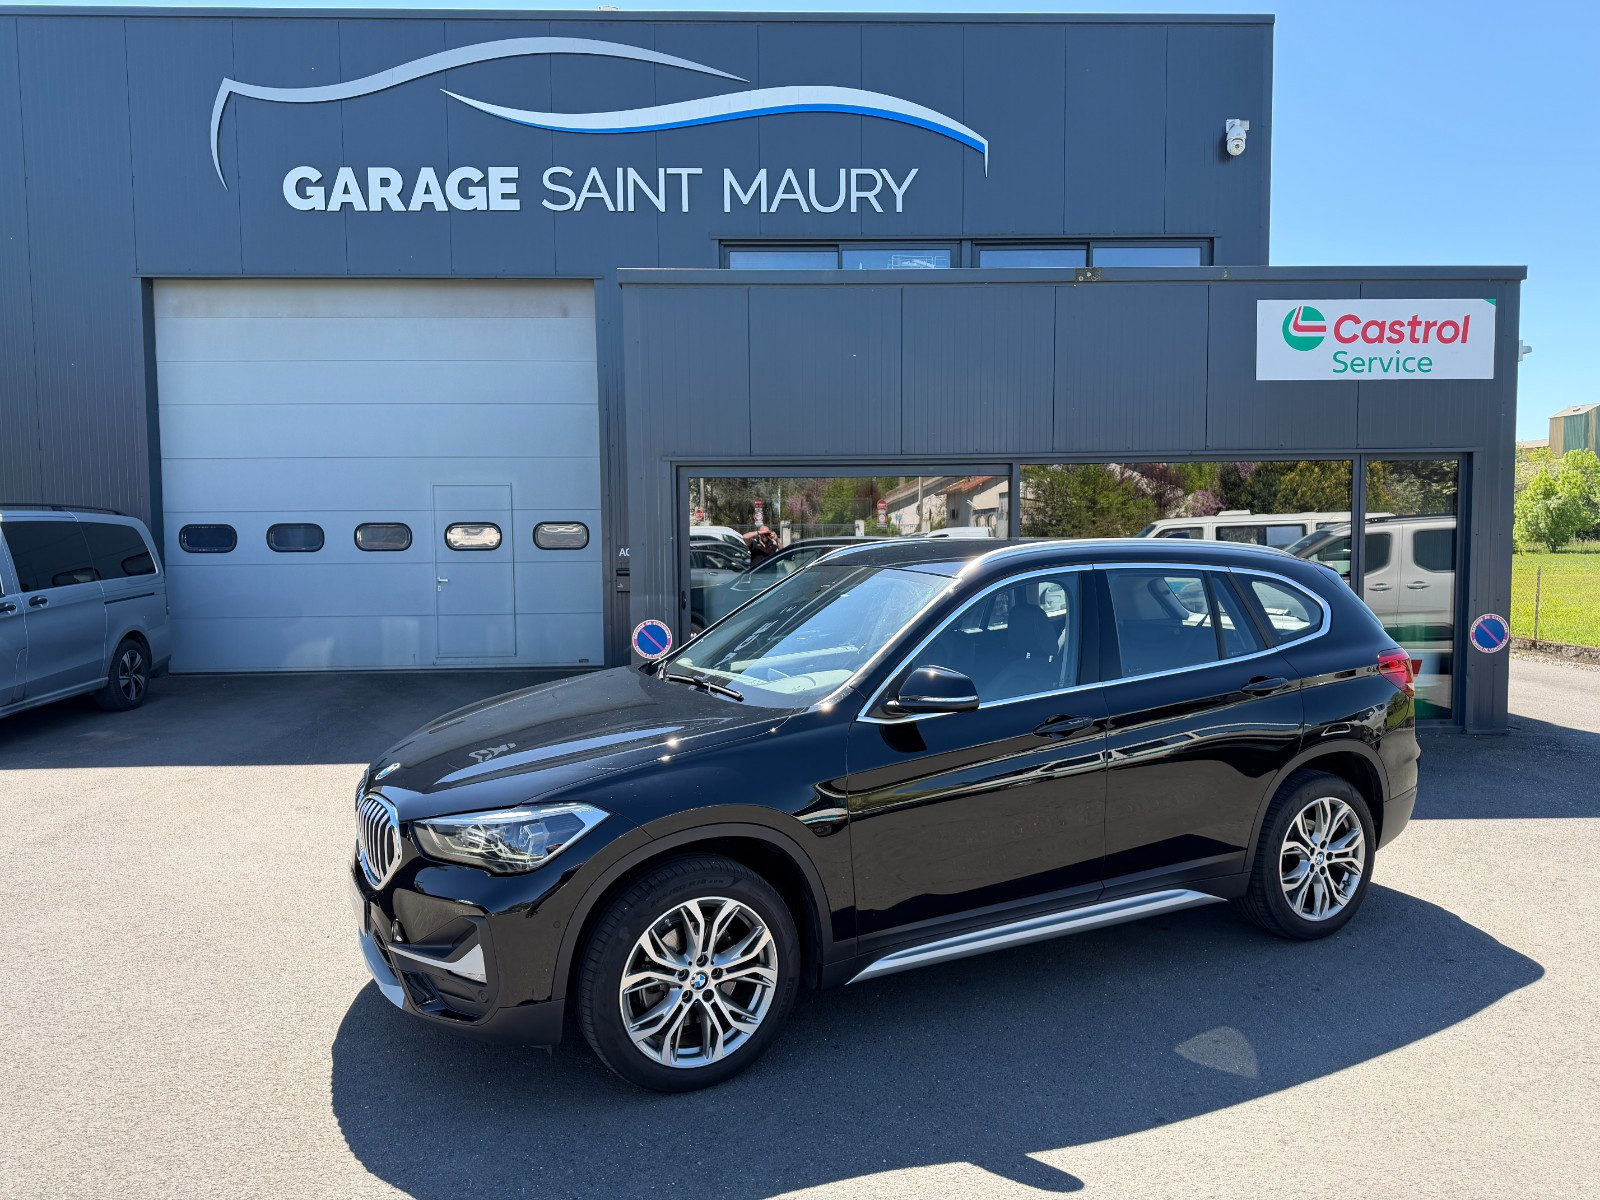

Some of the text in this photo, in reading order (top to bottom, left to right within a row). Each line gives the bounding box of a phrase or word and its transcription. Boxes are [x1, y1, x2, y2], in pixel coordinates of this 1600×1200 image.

[282, 165, 919, 214] GARAGE SAINT MAURY
[1333, 314, 1471, 345] Castrol
[1332, 350, 1433, 373] Service
